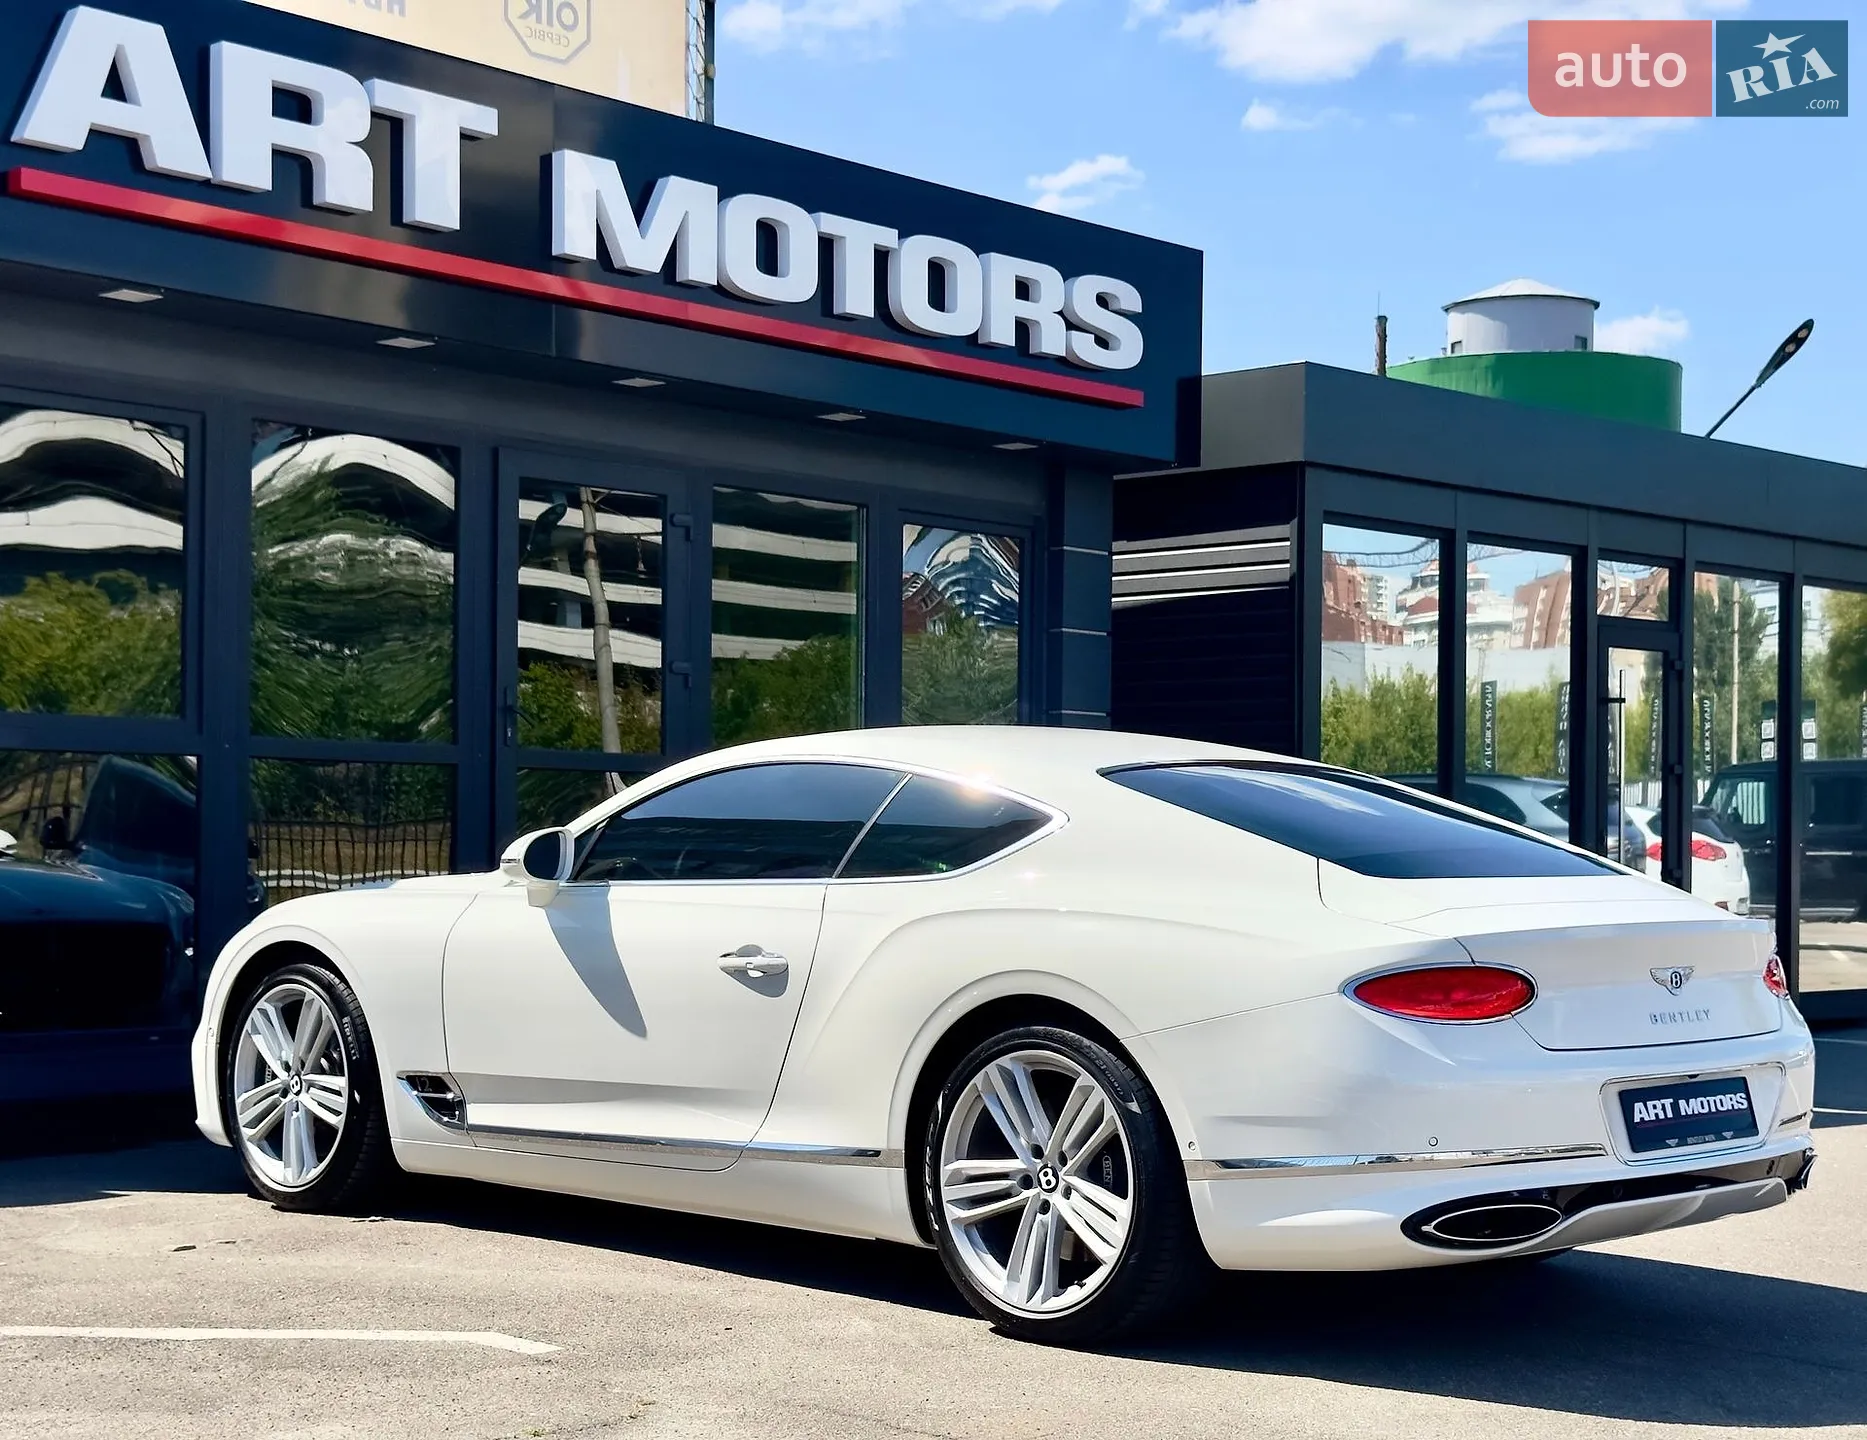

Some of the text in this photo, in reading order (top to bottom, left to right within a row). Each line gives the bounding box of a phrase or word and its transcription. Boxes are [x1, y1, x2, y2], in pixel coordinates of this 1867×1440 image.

[11, 5, 1144, 370] ART MOTORS
[1649, 1009, 1710, 1025] BENTLEY
[1634, 1092, 1749, 1123] ART MOTORS
